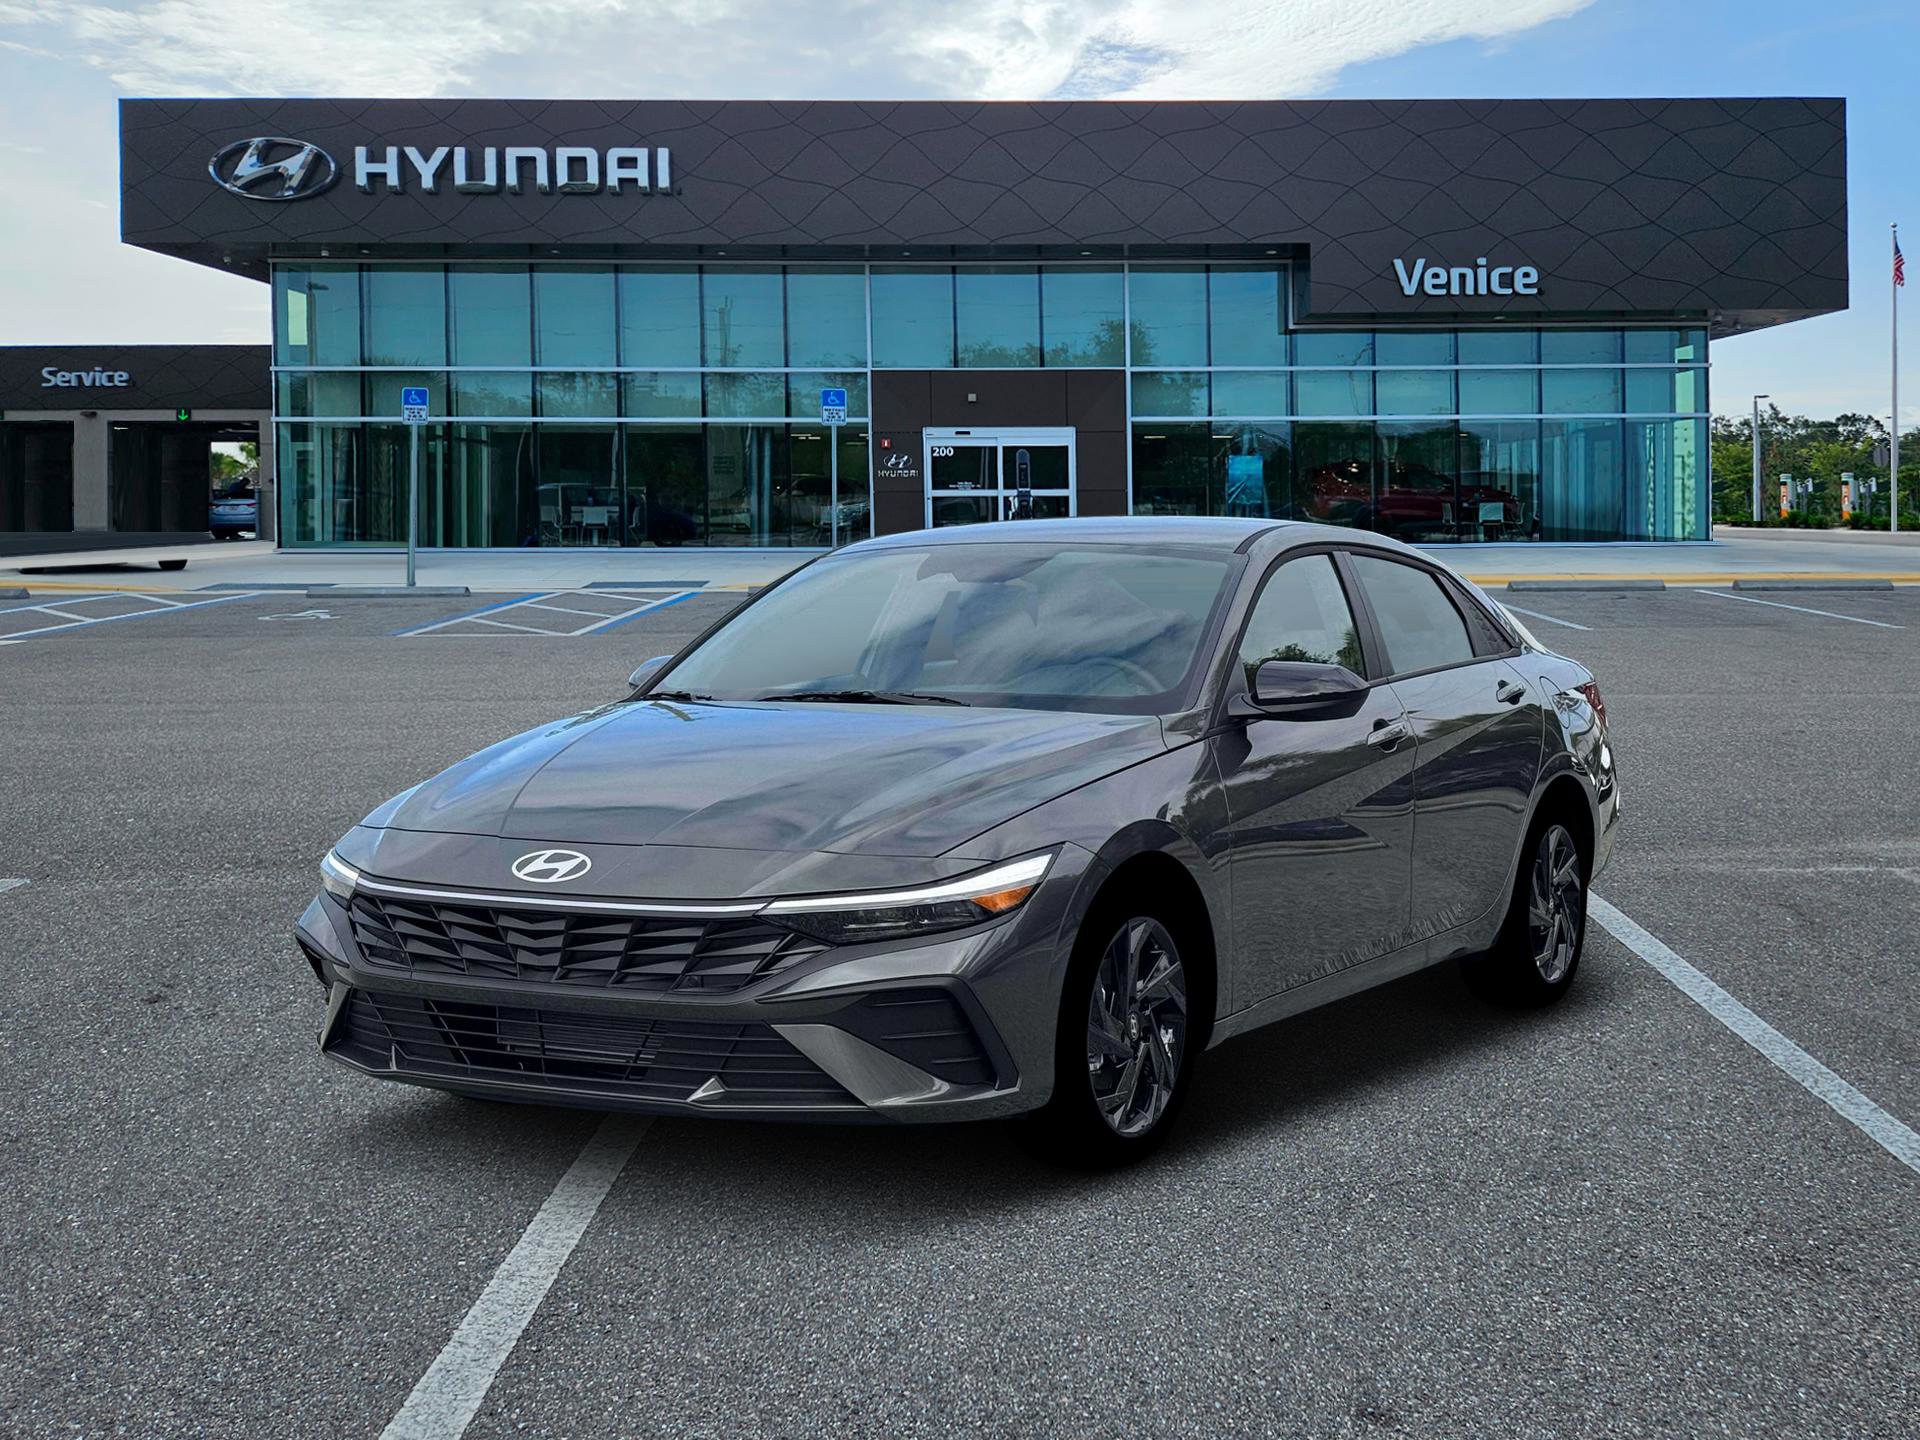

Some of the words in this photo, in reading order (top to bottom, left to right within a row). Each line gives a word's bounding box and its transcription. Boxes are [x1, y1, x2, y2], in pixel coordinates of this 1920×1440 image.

[354, 146, 671, 195] HYUNDAI
[1392, 256, 1540, 296] Venice
[41, 366, 129, 387] Service
[932, 446, 953, 457] 200
[877, 469, 918, 478] HYUNDAI
